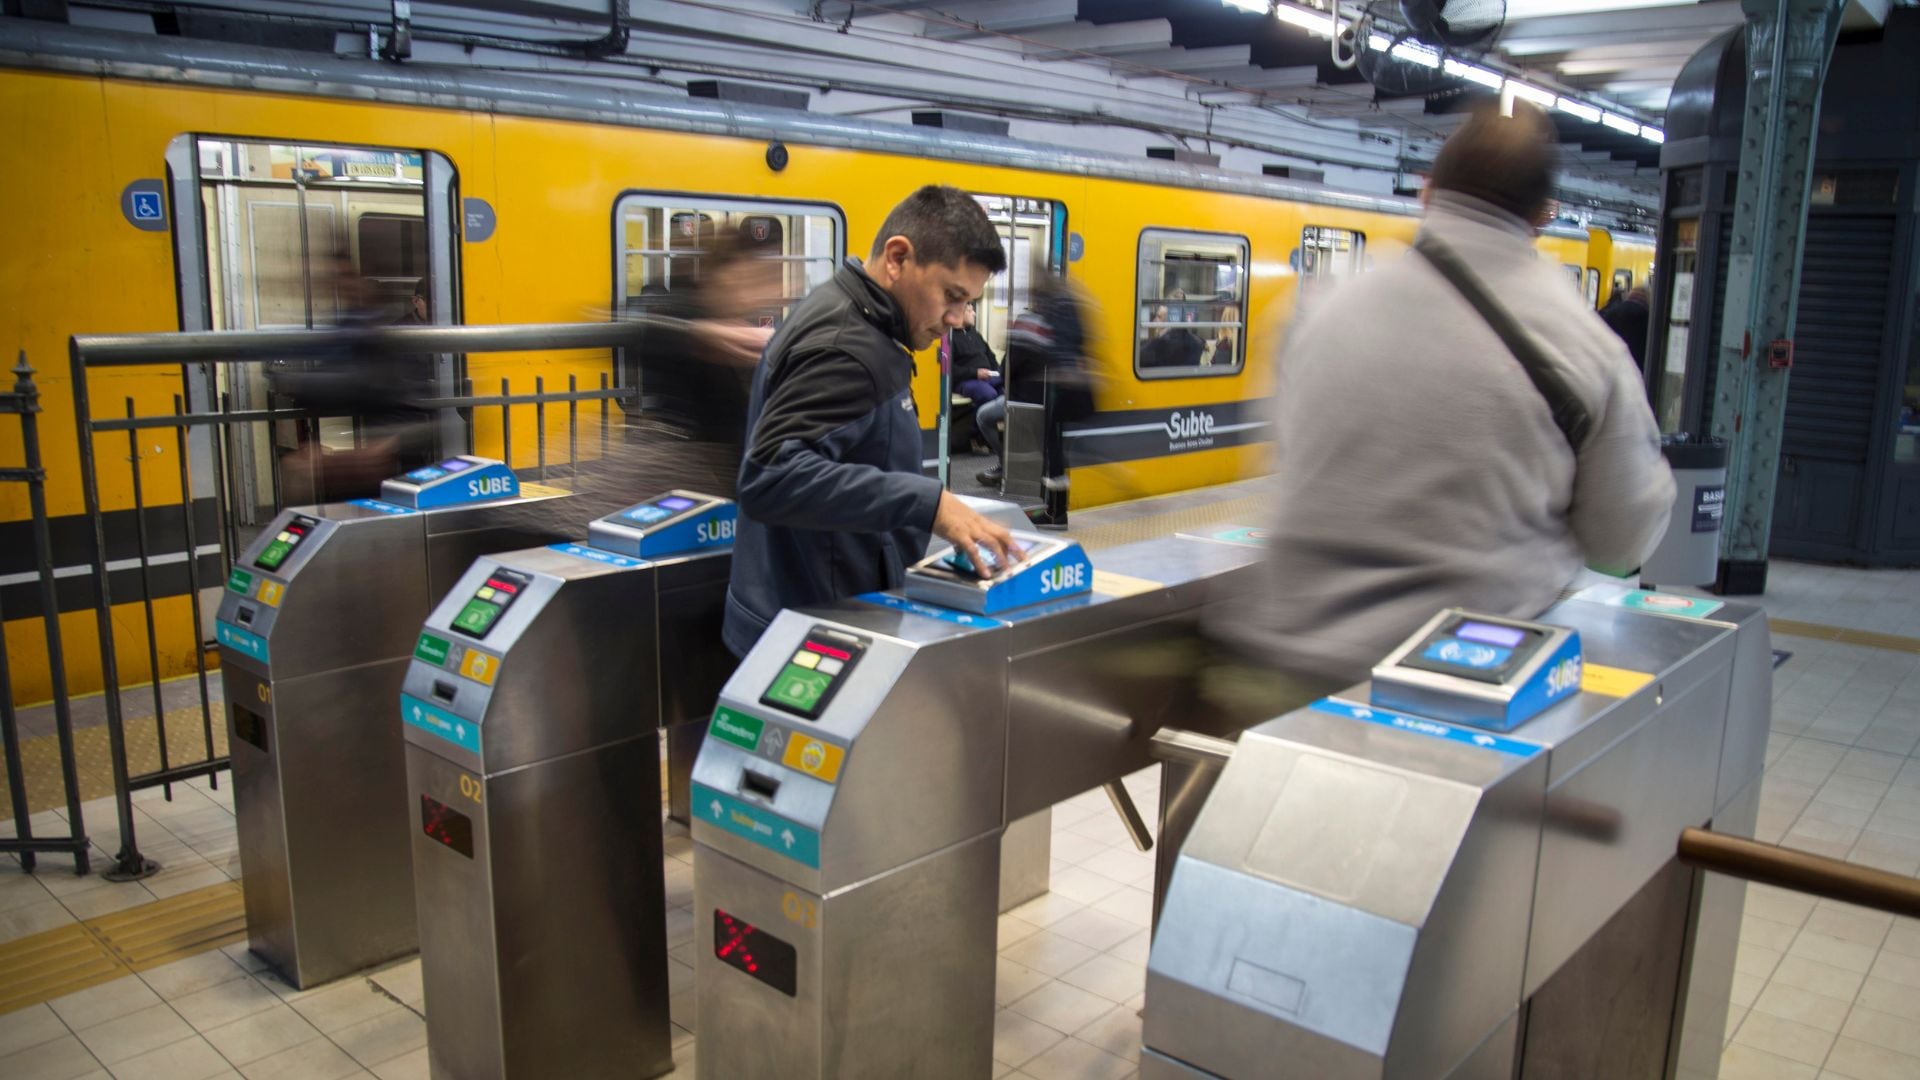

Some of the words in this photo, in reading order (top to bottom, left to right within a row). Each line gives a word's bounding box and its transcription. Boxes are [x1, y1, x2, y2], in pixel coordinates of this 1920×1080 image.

[1169, 409, 1215, 440] Subte
[468, 475, 512, 497] SUBE
[1040, 561, 1085, 594] SUBE
[1545, 655, 1582, 697] SUBE
[257, 683, 272, 705] 01
[459, 774, 482, 803] 02
[782, 892, 818, 930] 03
